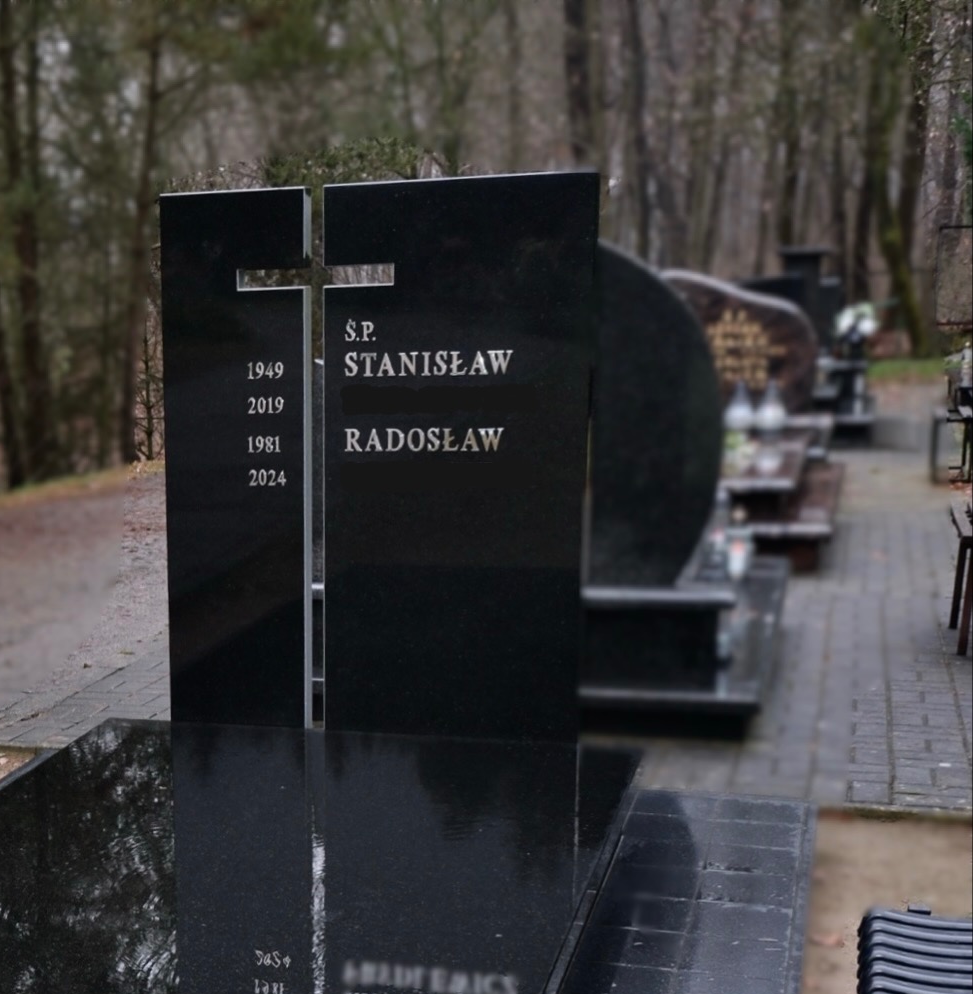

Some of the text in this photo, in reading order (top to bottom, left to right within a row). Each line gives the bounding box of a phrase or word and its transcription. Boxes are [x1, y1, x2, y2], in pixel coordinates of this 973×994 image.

[344, 318, 377, 342] Ś.P.
[247, 361, 284, 380] 1949
[344, 349, 514, 378] STANISŁAW
[247, 396, 285, 415] 2019
[247, 435, 282, 453] 1981
[344, 427, 505, 453] RADOSŁAW
[248, 468, 287, 487] 2024
